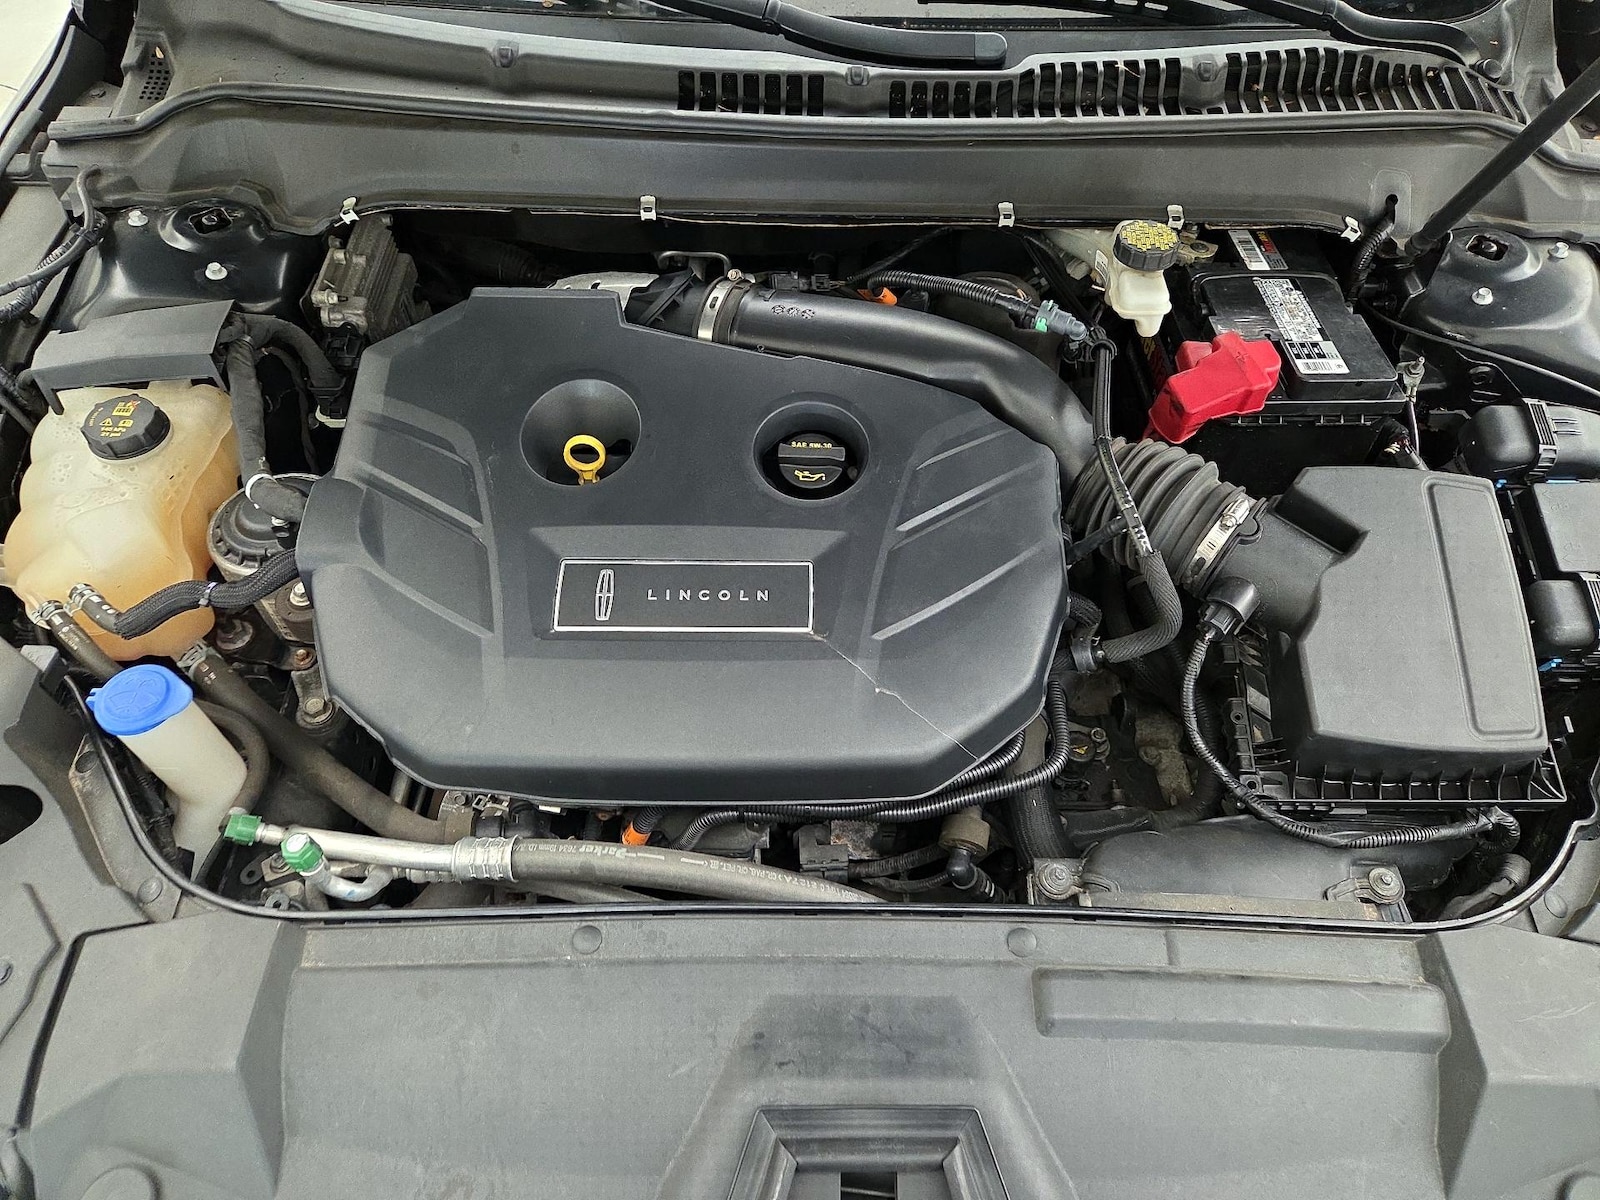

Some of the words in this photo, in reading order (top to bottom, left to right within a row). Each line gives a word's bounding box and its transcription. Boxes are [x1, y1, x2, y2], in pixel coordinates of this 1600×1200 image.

[791, 441, 808, 449] SAE
[647, 588, 770, 602] LINCOLN
[579, 844, 628, 859] Parker
